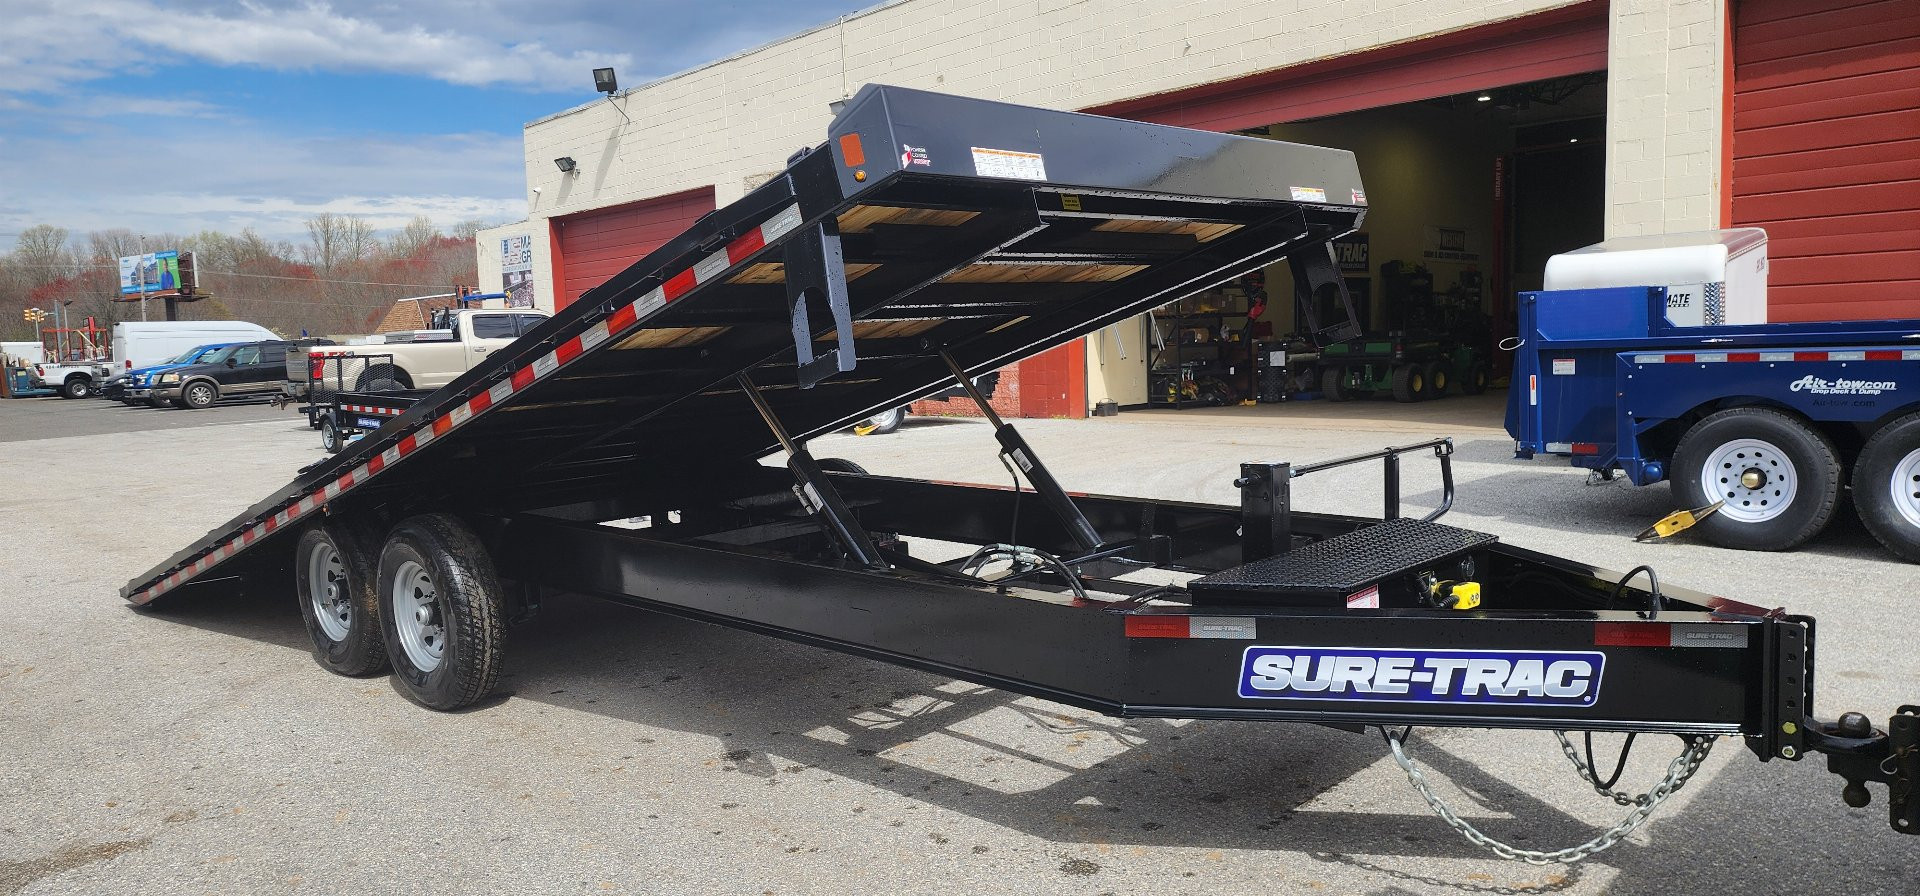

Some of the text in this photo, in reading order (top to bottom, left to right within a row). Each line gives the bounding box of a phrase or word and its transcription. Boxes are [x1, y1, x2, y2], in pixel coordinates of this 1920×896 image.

[1789, 375, 1898, 392] Air-tow.com
[1858, 388, 1881, 396] Dump
[1250, 654, 1592, 698] SURE-TRAC
